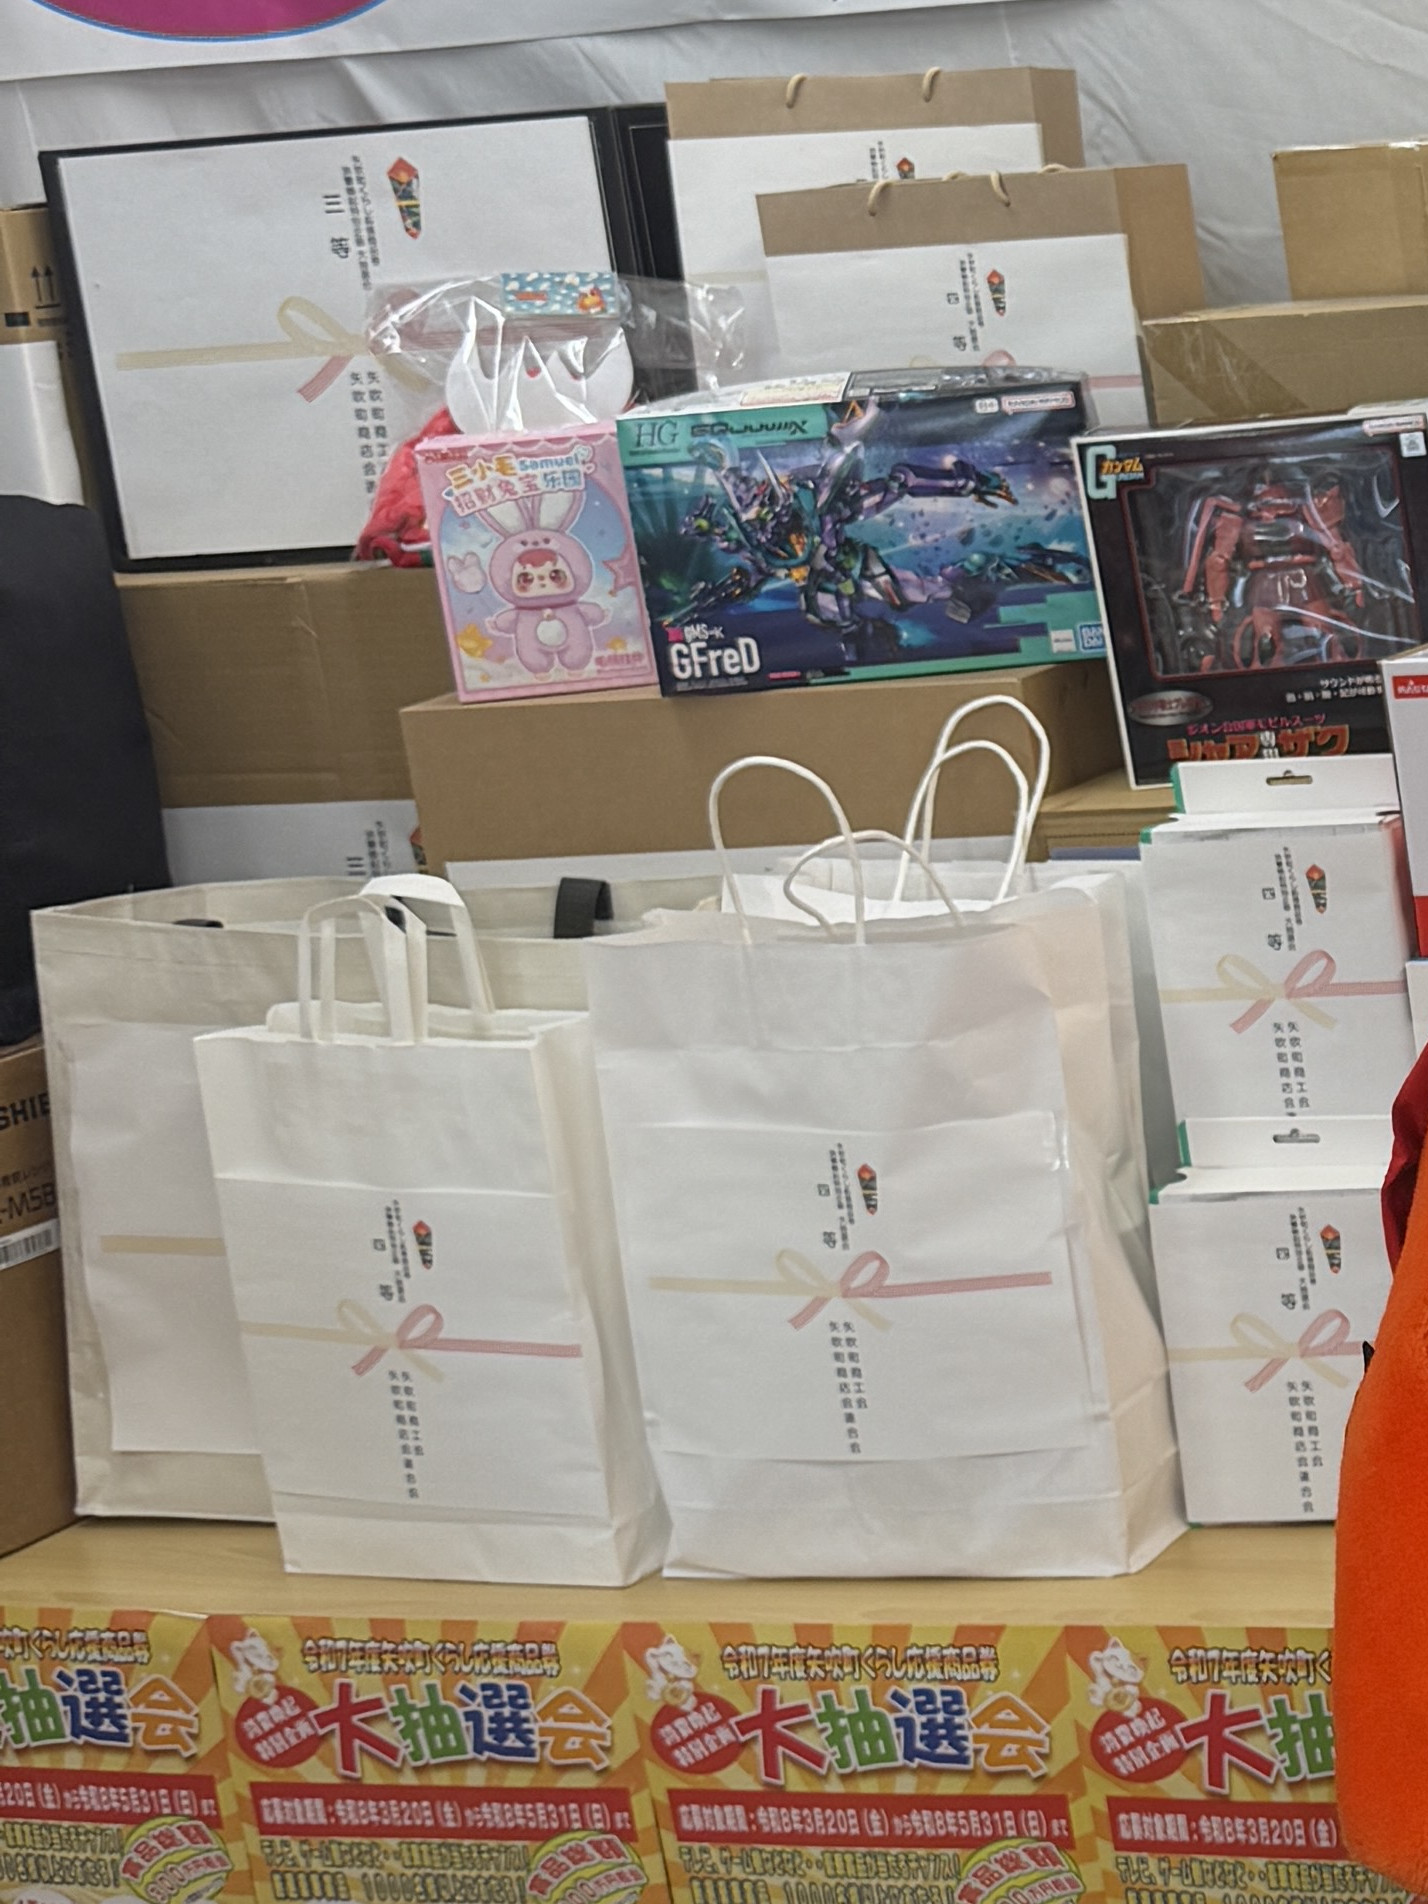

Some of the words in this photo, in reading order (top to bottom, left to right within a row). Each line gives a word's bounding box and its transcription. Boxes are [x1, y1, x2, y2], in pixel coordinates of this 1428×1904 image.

[635, 422, 679, 447] HG
[670, 638, 761, 680] GFreD
[312, 1678, 613, 1780] 大抽選会
[729, 1684, 1051, 1786] 大抽選会
